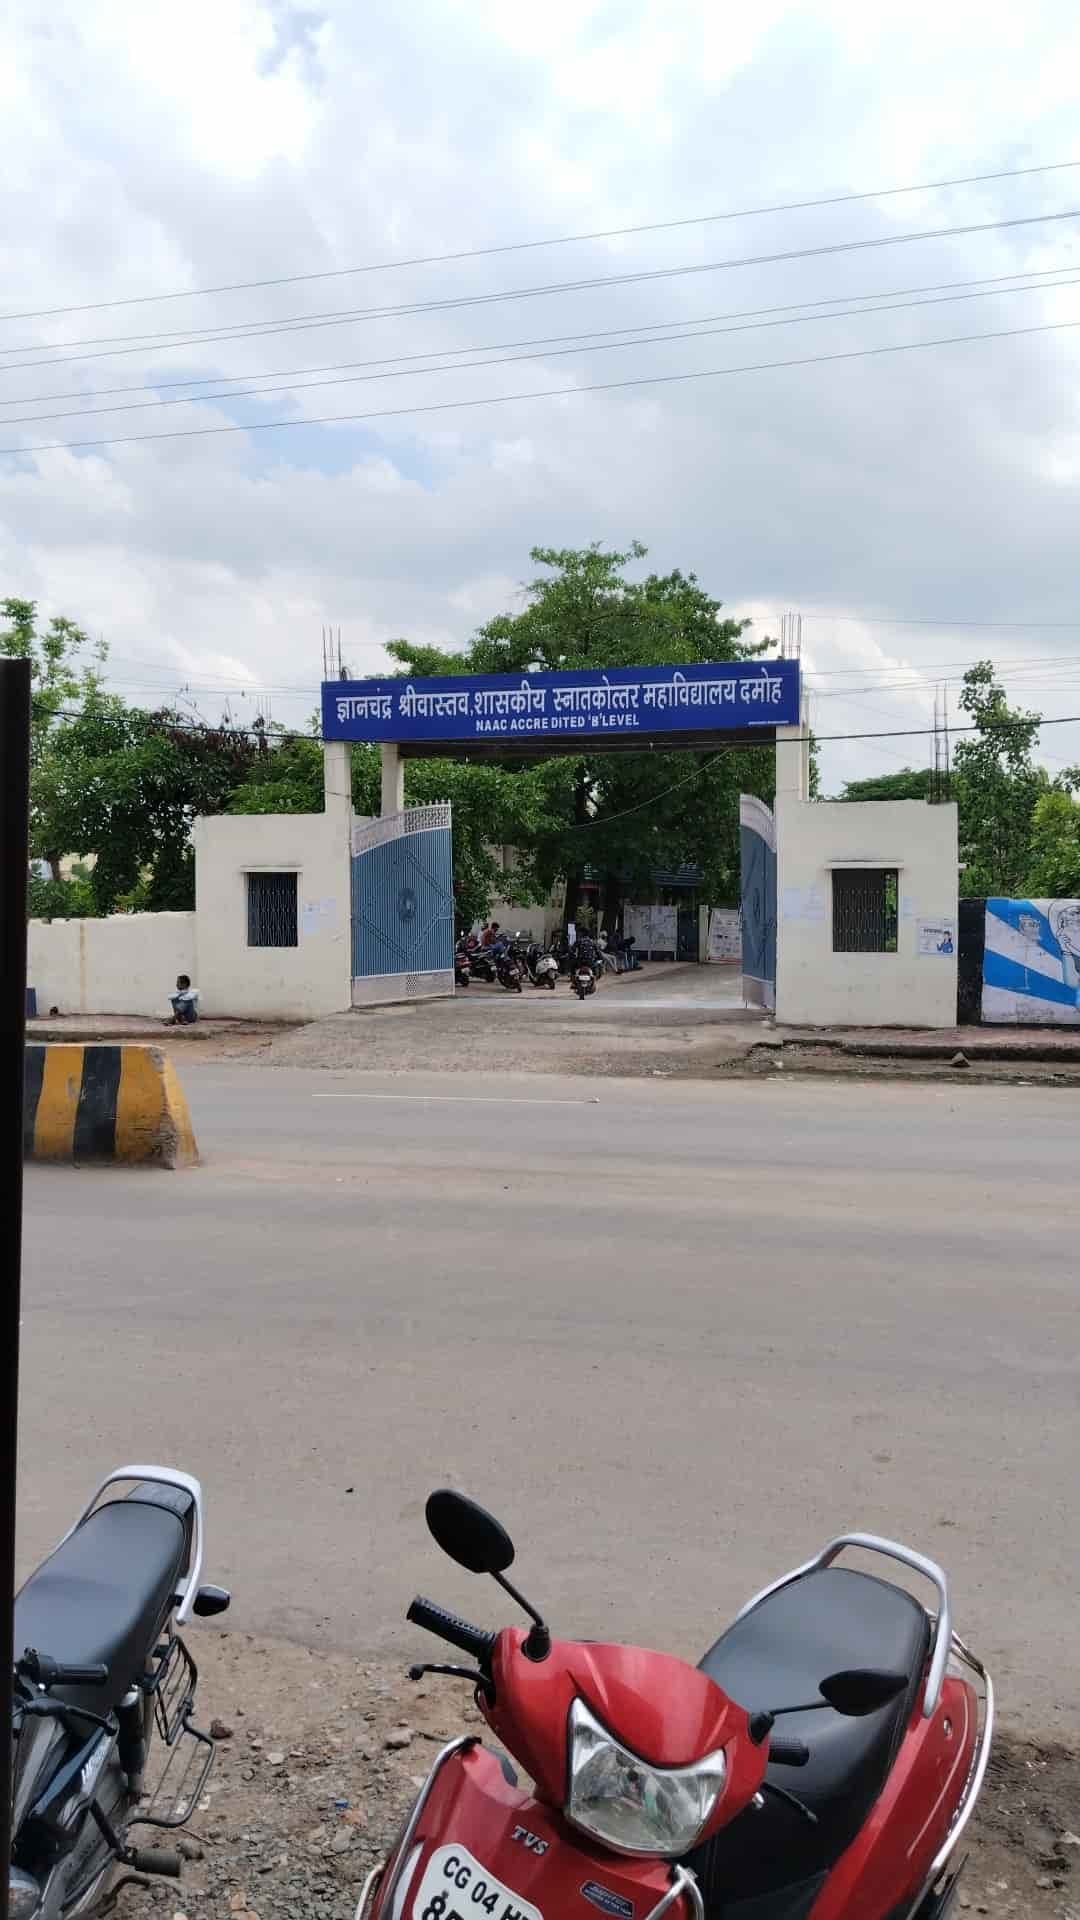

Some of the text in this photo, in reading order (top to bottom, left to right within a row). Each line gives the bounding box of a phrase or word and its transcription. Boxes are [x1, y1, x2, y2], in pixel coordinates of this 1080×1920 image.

[336, 688, 392, 722] ज्ञानचंद्र
[552, 675, 640, 711] स्नातकोत्तर
[642, 672, 737, 709] महाविद्यालय
[739, 667, 782, 704] दमोह
[476, 719, 508, 732] NAAC
[512, 1824, 549, 1855] TVS
[443, 1856, 472, 1889] CG
[471, 1881, 500, 1914] 04
